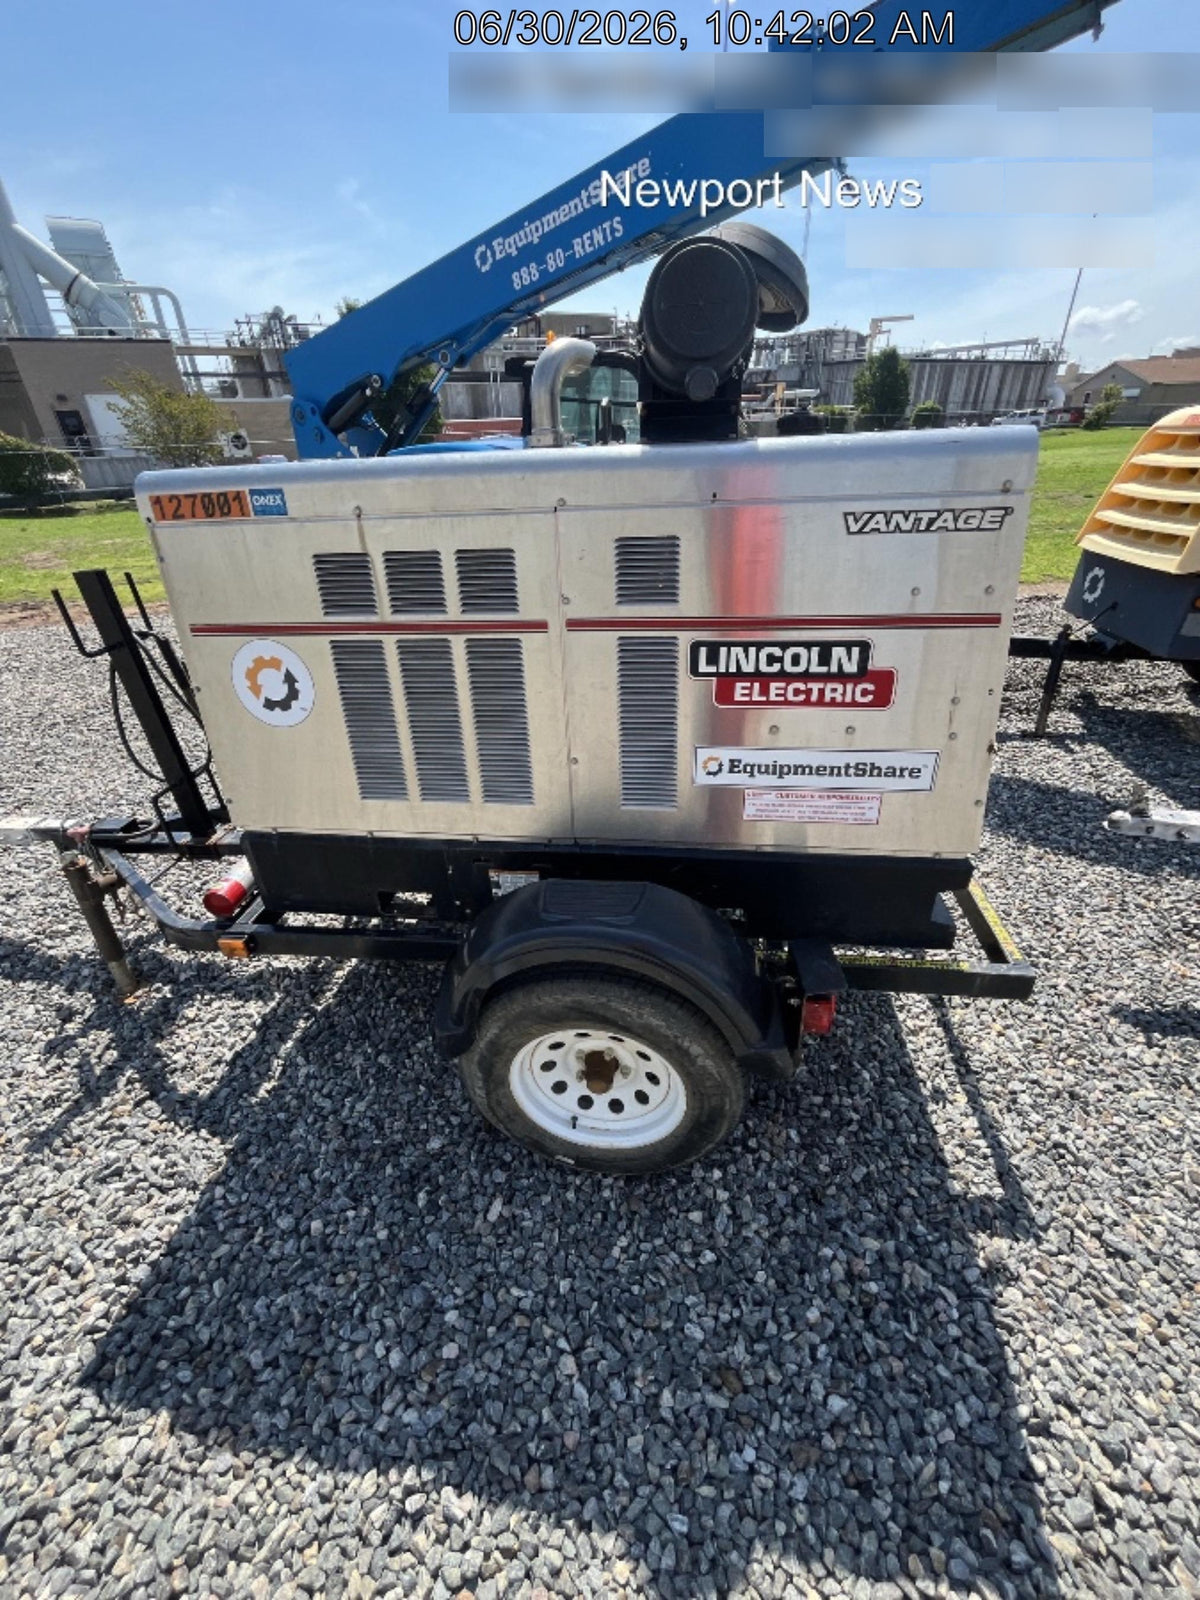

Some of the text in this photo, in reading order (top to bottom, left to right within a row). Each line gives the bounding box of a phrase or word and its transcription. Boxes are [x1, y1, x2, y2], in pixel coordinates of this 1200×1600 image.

[492, 156, 651, 261] EquipmentSare
[511, 216, 624, 291] 888-80-RENTS
[153, 490, 245, 519] 127001
[844, 507, 1007, 534] VANTAGE
[697, 646, 860, 673] LINCOLN
[733, 681, 875, 703] ELECTRIC
[727, 758, 923, 780] EquipmentShare
